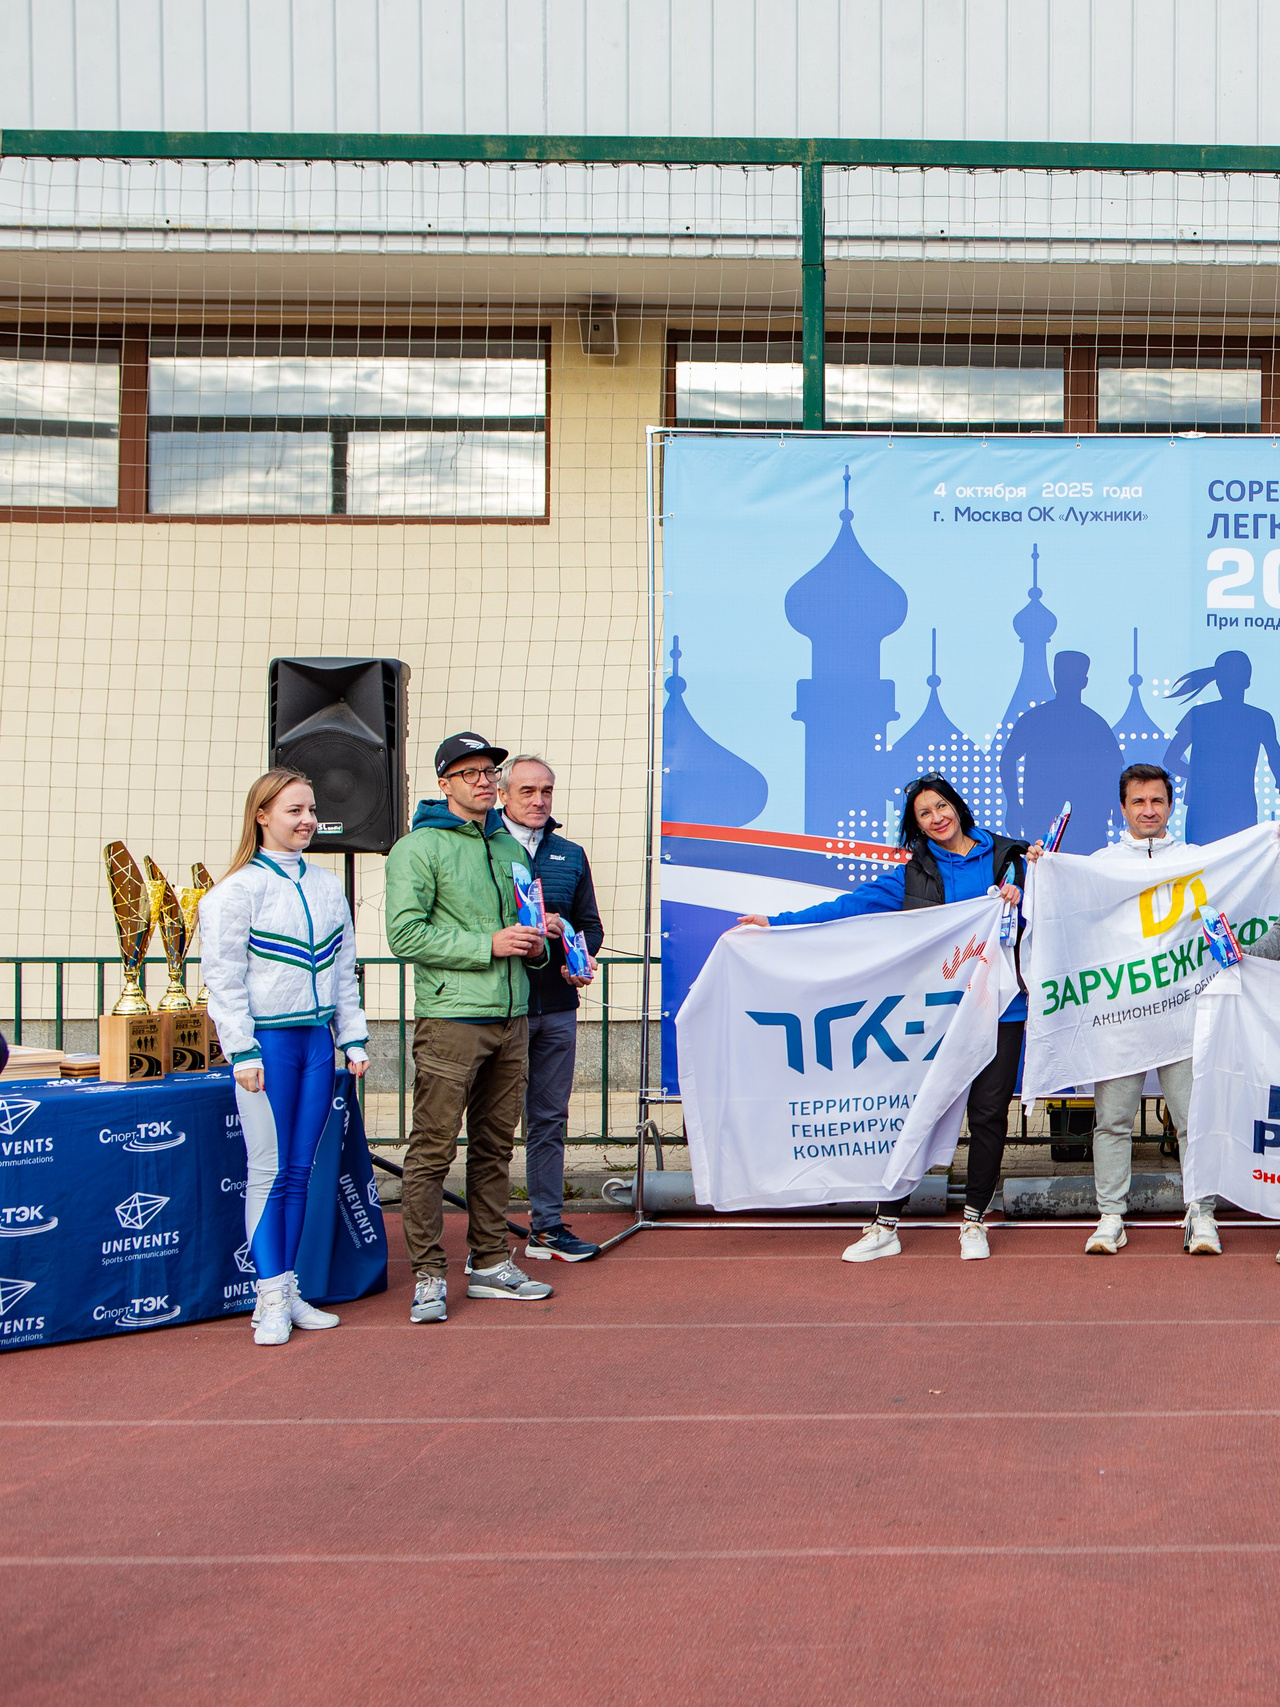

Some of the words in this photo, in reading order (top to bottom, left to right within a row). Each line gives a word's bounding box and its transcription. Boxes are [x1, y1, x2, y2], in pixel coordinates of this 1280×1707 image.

[934, 482, 947, 498] 4
[955, 483, 1027, 501] октября
[1042, 482, 1094, 498] 2025
[1102, 485, 1143, 500] года
[933, 511, 945, 523] г.
[954, 506, 1023, 523] Москва
[1027, 506, 1056, 523] ОК
[1058, 506, 1148, 526] «Лужники»
[1206, 613, 1240, 631] При
[1092, 989, 1191, 1028] АКЦИОНЕРНОЕ
[1, 1137, 54, 1156] VENTS
[102, 1230, 180, 1255] UNEVENTS
[101, 1256, 124, 1266] Sports
[124, 1247, 180, 1262] communications
[0, 1316, 46, 1336] ENTS
